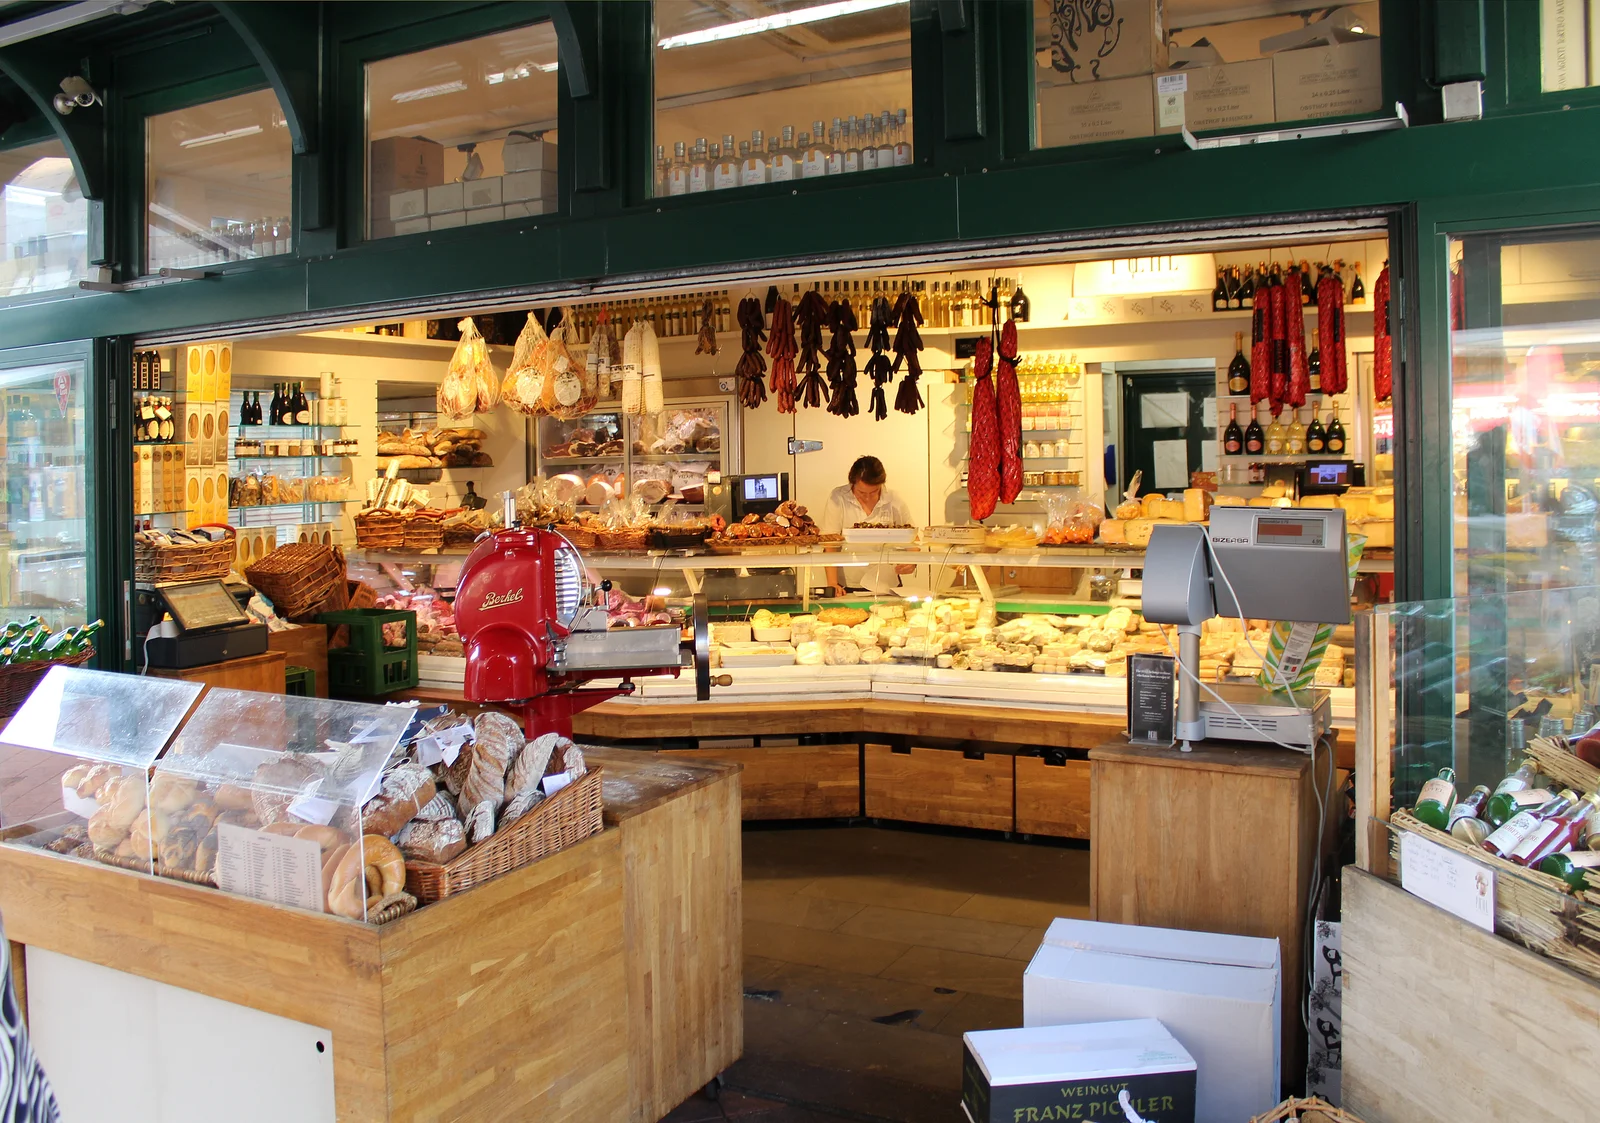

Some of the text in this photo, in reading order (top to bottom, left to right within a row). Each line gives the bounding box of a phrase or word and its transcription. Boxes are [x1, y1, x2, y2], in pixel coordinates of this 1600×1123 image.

[478, 588, 524, 610] Berkel
[1061, 1083, 1130, 1098] WEINGUT
[1013, 1095, 1175, 1123] FRANZ PICLER
